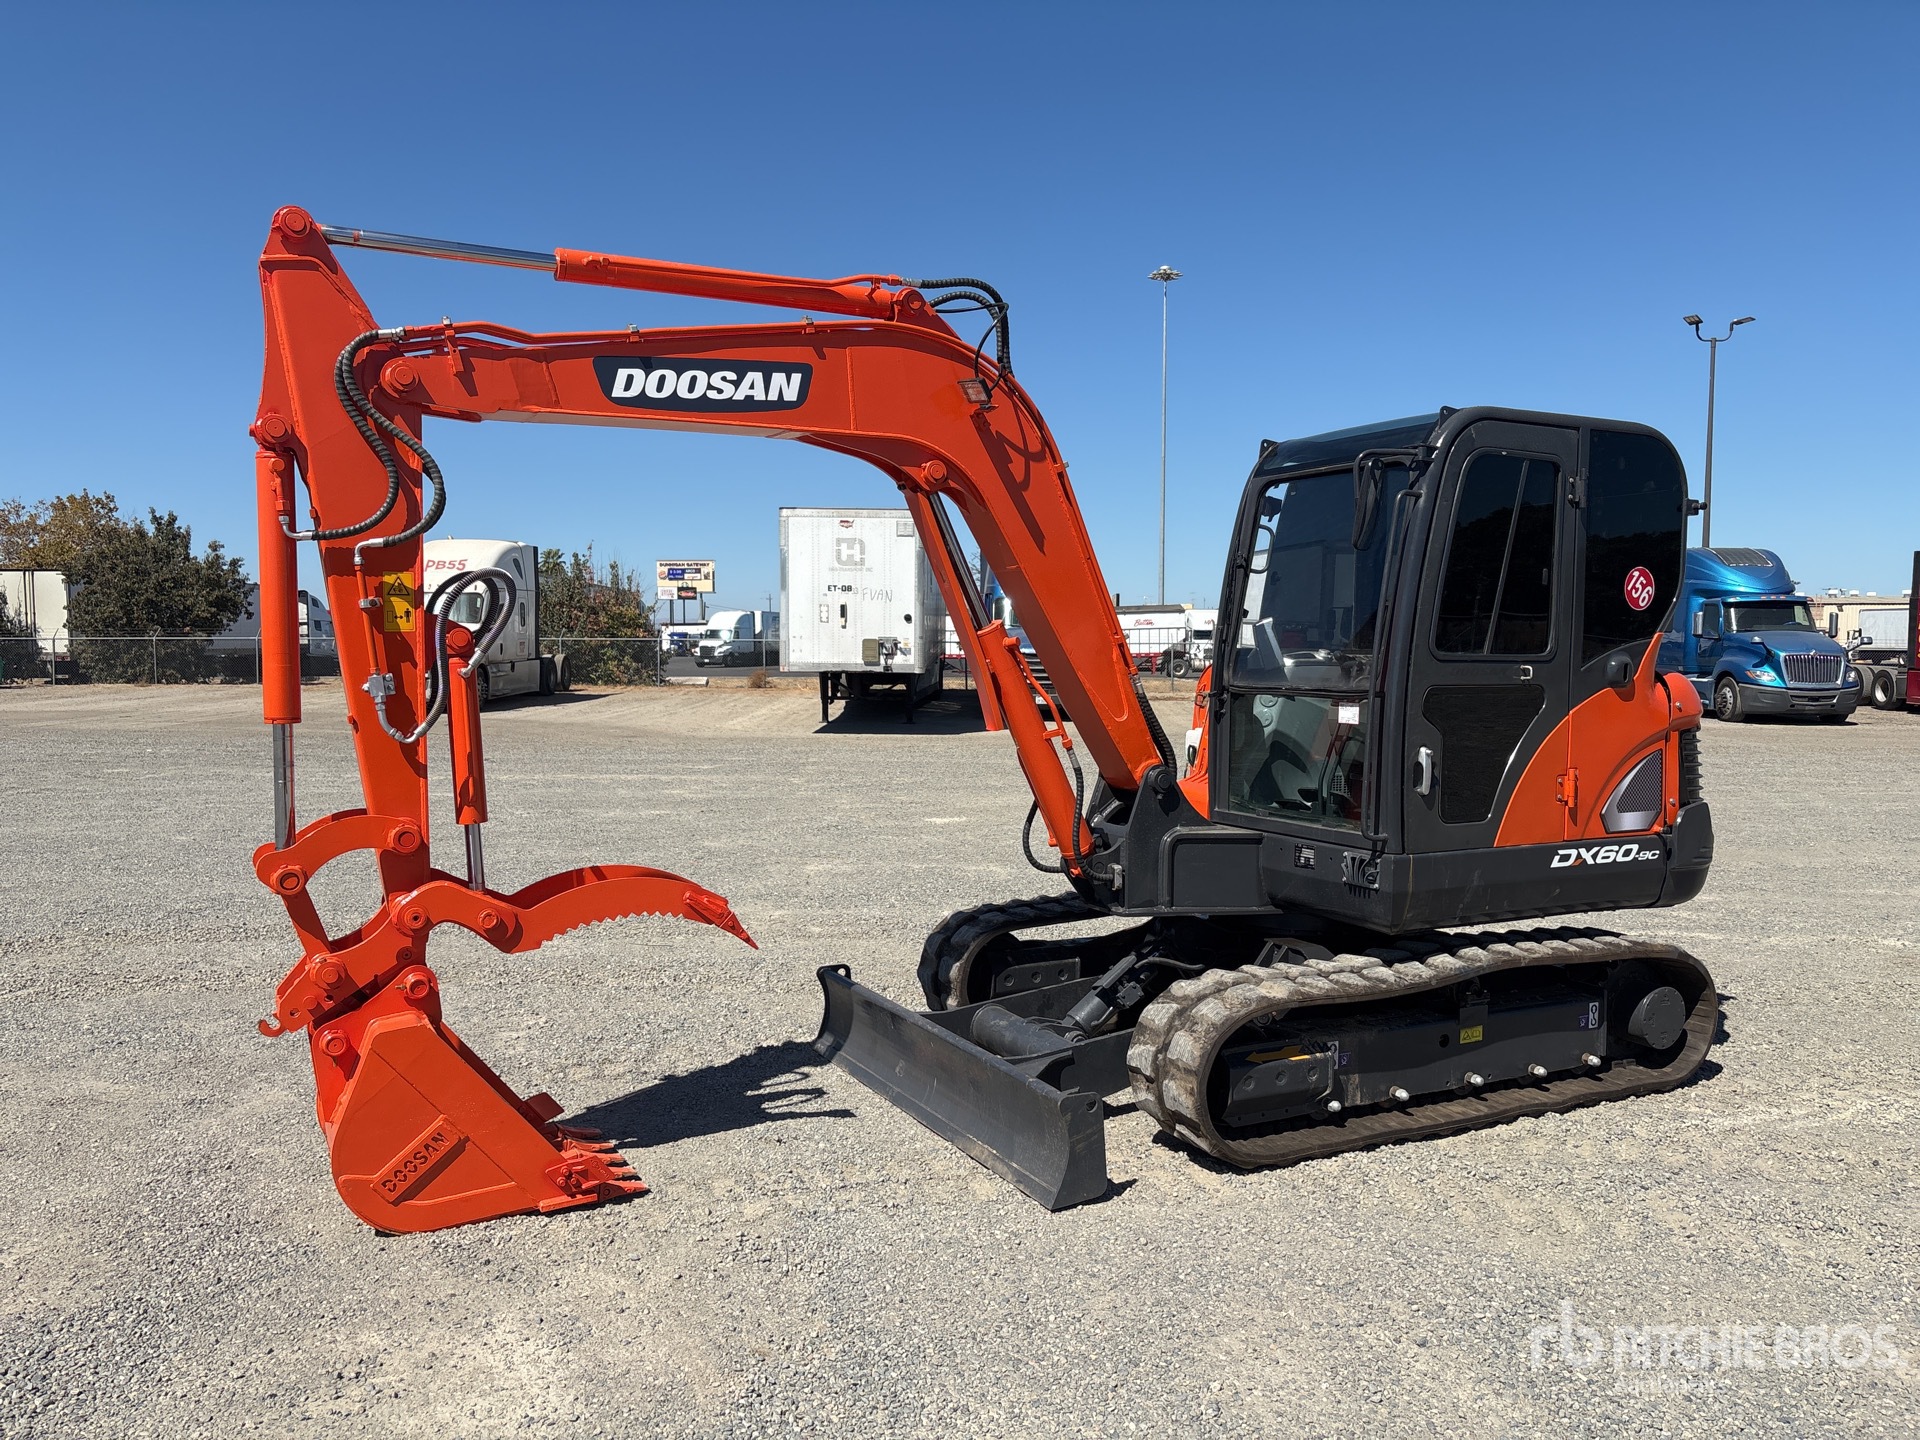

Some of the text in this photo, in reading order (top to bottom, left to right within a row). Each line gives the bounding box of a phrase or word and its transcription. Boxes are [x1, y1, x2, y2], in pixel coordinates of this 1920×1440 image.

[611, 368, 802, 402] DOOSAN
[425, 559, 468, 572] PB55
[827, 584, 853, 592] ET-08
[1627, 570, 1653, 607] 156
[1550, 844, 1660, 868] DX60-9C
[381, 1131, 450, 1195] DOOSAN
